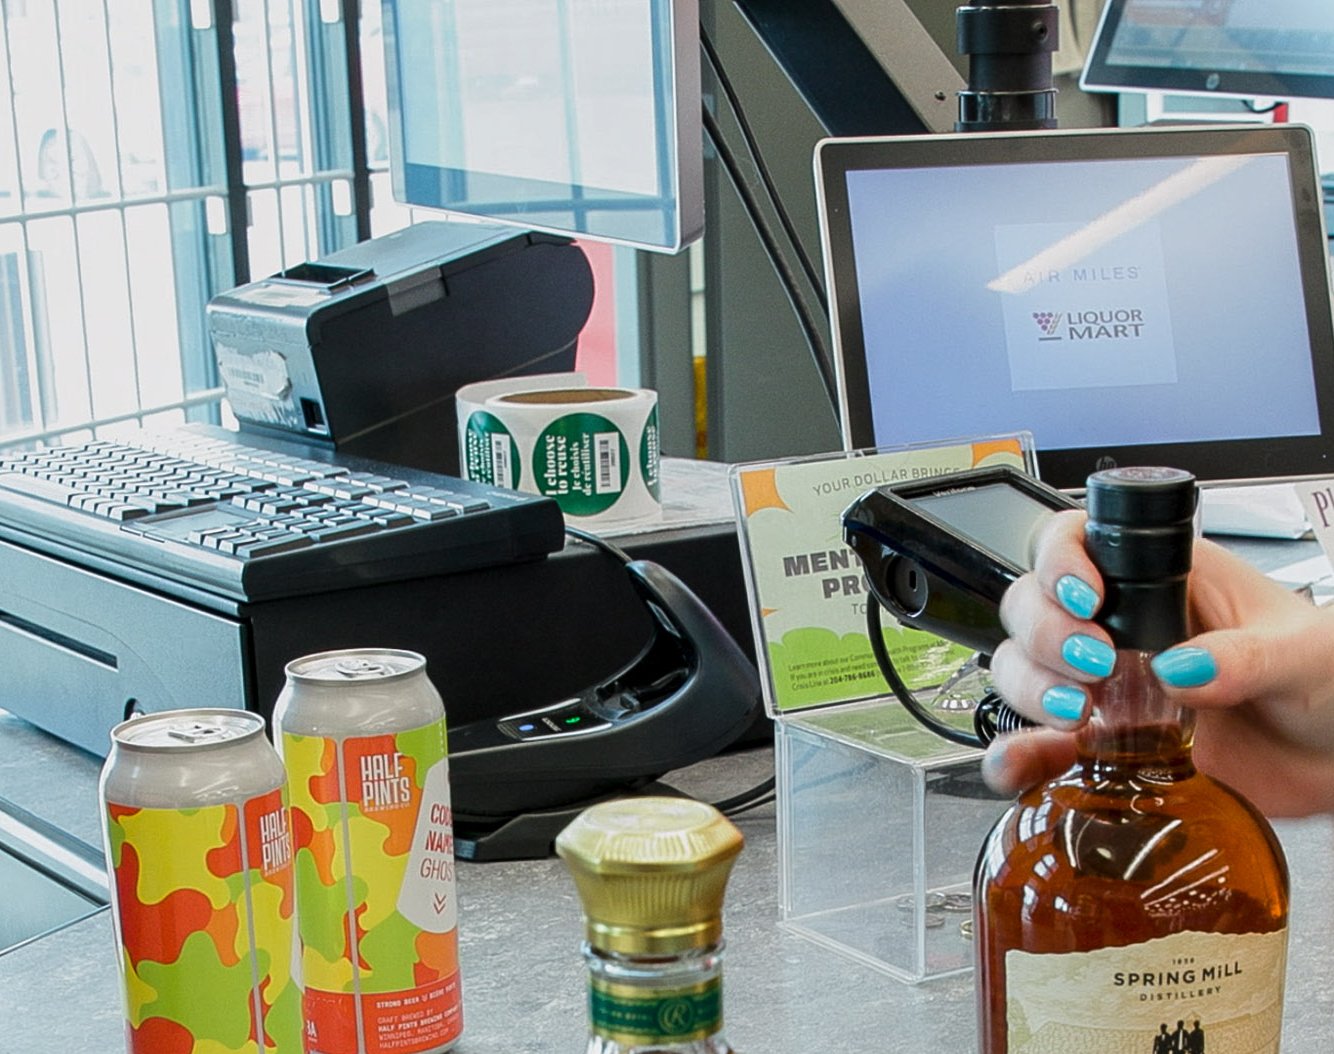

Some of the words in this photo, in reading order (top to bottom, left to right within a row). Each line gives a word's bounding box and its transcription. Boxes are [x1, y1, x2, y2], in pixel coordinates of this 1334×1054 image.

[1073, 266, 1138, 281] MILES
[1067, 309, 1143, 326] LIQUOR
[1069, 323, 1145, 340] MART
[543, 434, 557, 487] choose
[556, 435, 568, 477] reuse
[570, 441, 581, 479] choisis
[557, 480, 569, 496] to
[572, 480, 582, 491] Je
[582, 482, 592, 496] de
[812, 479, 851, 497] YOUR
[853, 467, 908, 487] DOLLAR
[911, 466, 961, 479] BRIN
[782, 548, 865, 578] MENT
[822, 576, 871, 600] PRO
[360, 751, 403, 782] HALF
[362, 776, 411, 807] PINTS
[260, 807, 287, 845] HALF
[431, 803, 453, 827] COD
[262, 831, 291, 872] PINTS
[420, 857, 454, 882] GHOS
[1113, 970, 1196, 987] SPRING
[1140, 986, 1221, 1002] DISTILLERY
